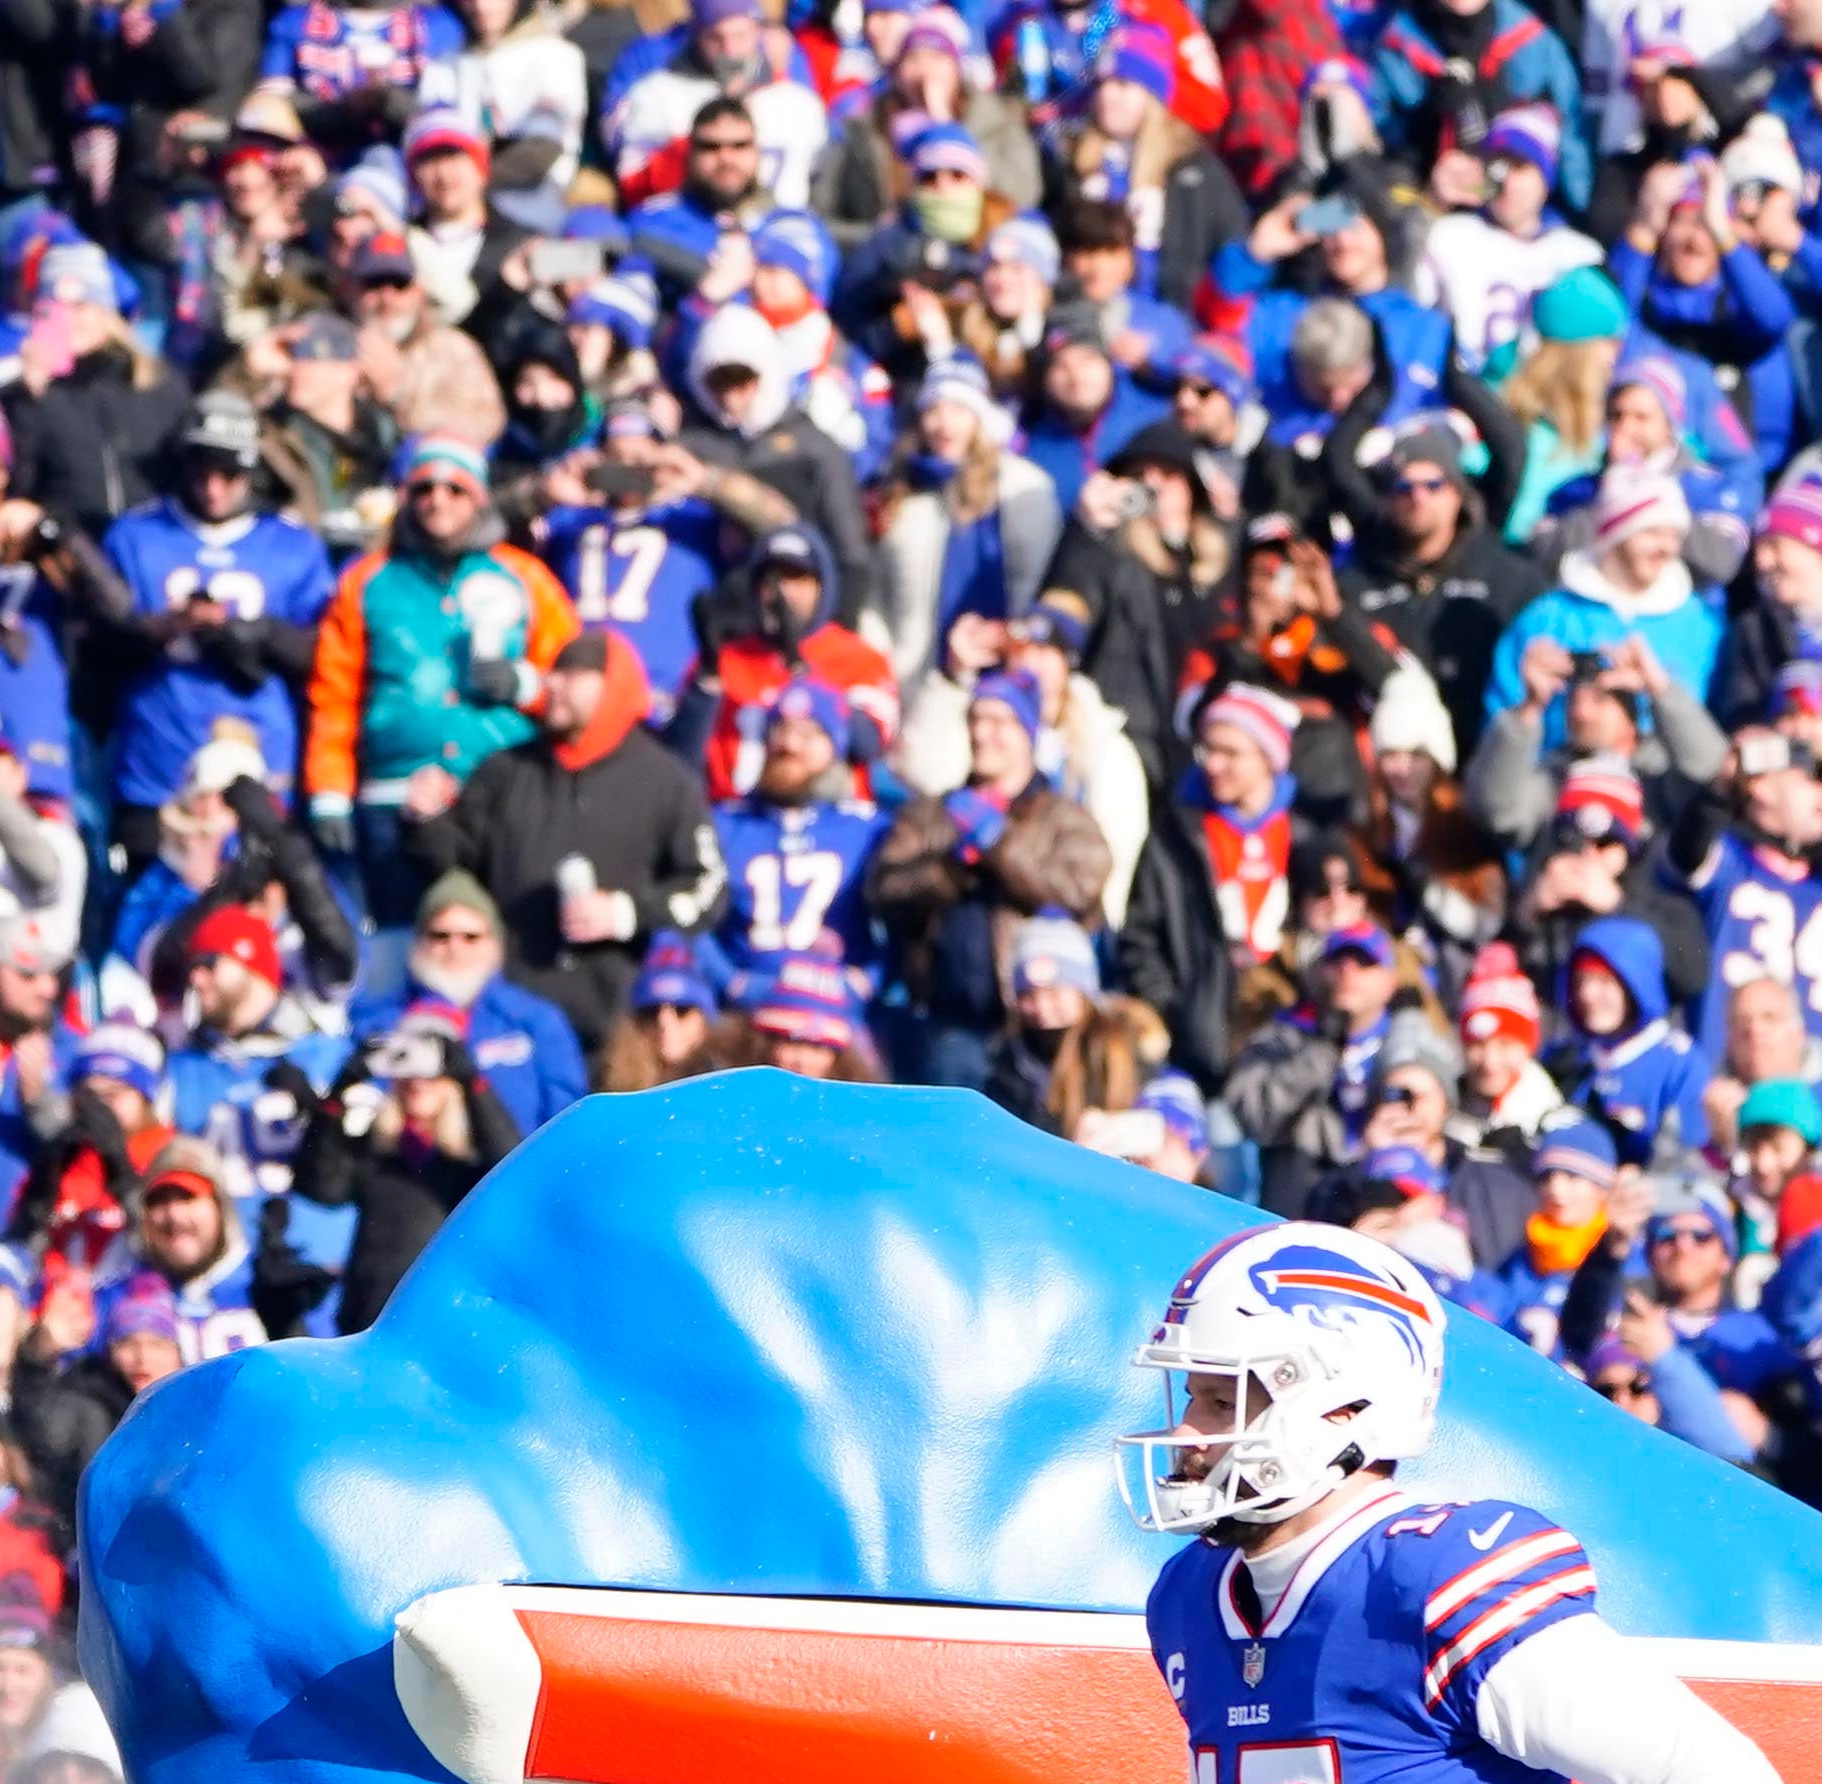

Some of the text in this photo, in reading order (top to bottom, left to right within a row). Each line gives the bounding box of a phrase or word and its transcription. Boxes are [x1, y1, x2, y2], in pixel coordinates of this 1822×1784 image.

[576, 524, 668, 622] 17
[745, 851, 842, 951] 17
[1166, 1651, 1186, 1700] C
[1226, 1704, 1271, 1727] BILLS
